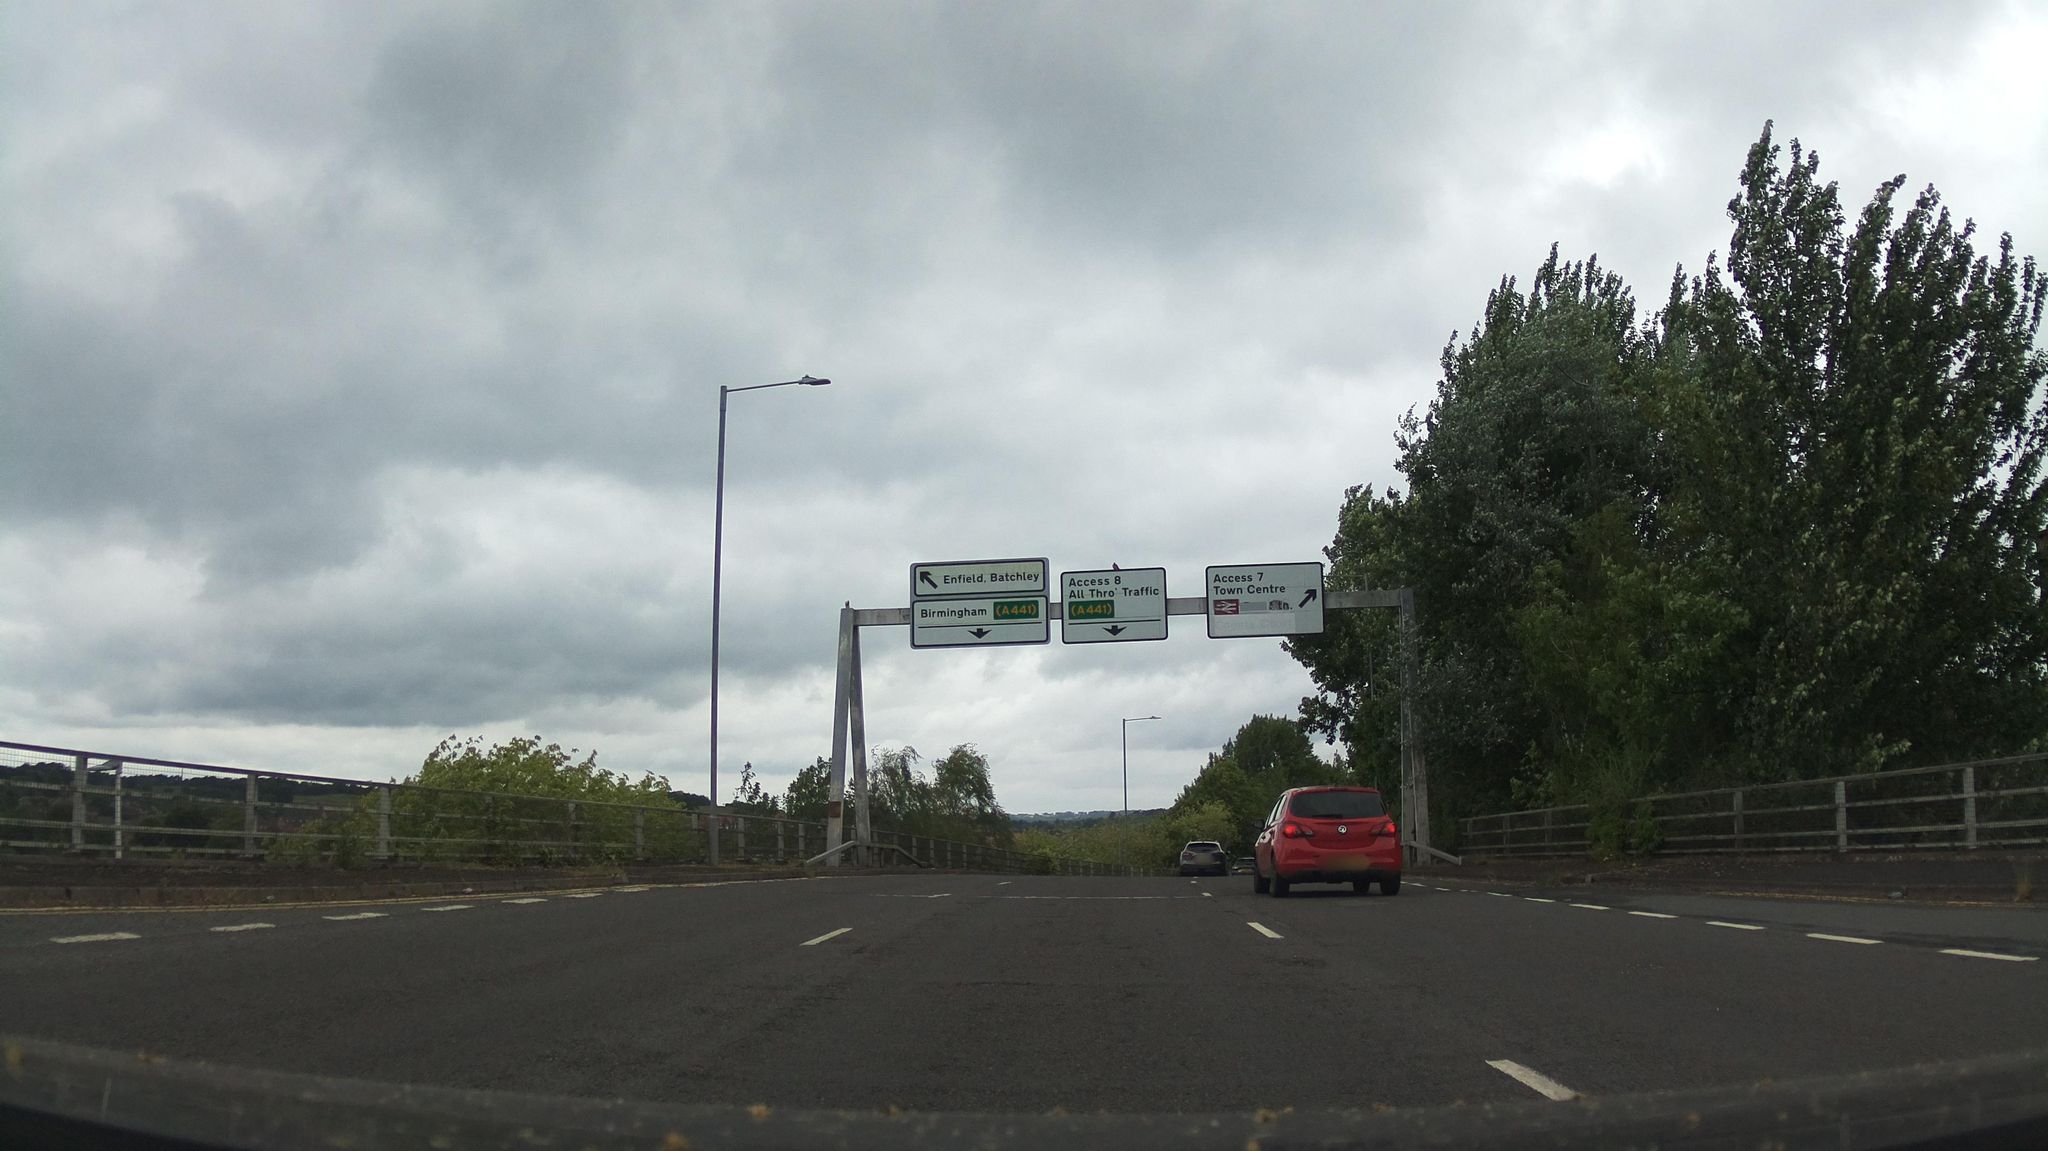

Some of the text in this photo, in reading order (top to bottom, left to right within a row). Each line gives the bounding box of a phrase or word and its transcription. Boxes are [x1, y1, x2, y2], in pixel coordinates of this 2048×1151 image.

[990, 572, 1040, 583] Batchley
[1069, 575, 1121, 587] Access 8
[1213, 572, 1264, 583] Access 7
[1069, 589, 1084, 599] All
[1122, 586, 1159, 597] Traffic
[1213, 584, 1286, 595] Town Centre
[921, 608, 987, 619] Birmingham
